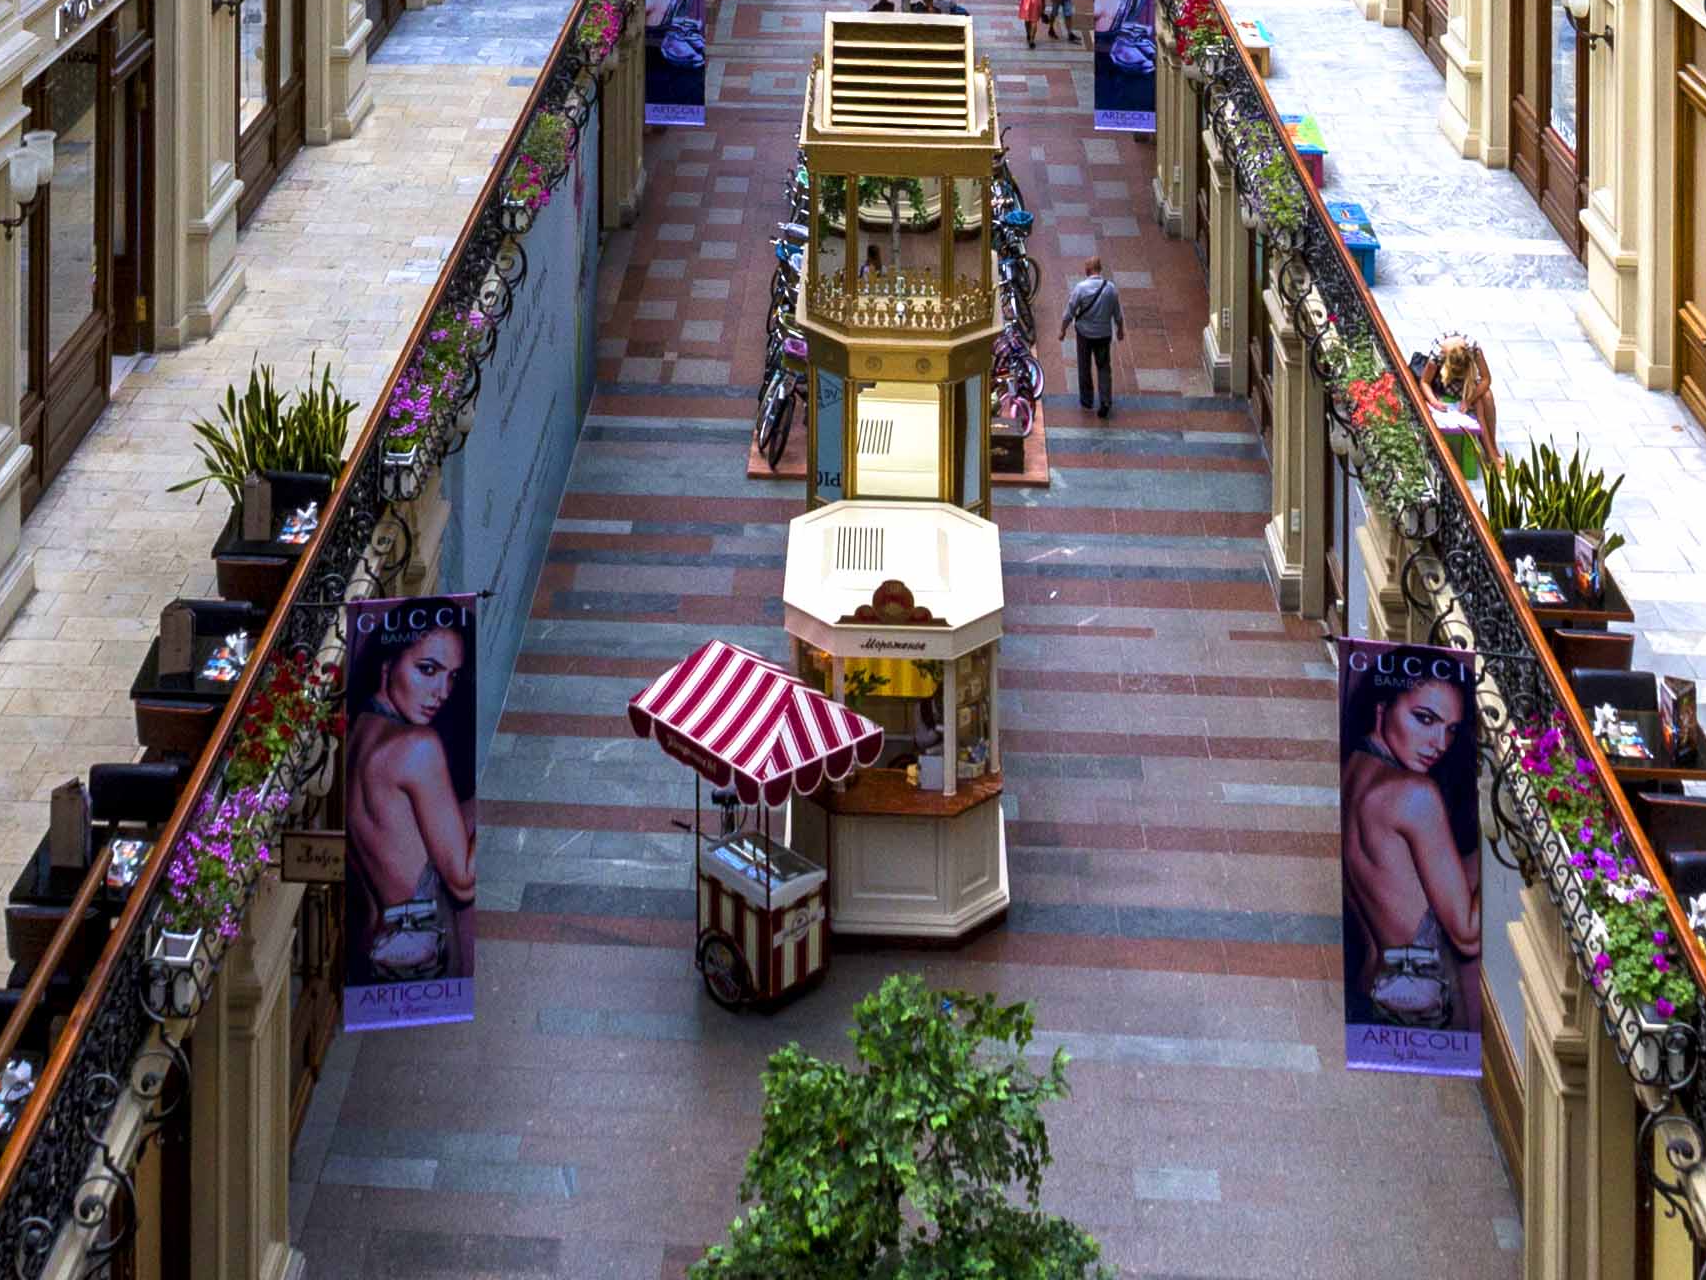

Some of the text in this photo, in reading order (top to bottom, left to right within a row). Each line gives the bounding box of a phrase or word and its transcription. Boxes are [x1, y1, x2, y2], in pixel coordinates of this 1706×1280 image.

[357, 607, 467, 633] GUCCI
[860, 637, 926, 653] Мороженое
[1348, 651, 1467, 683] GUCCI
[359, 981, 463, 1008] ARTICOLI
[1362, 1027, 1470, 1052] ARTICOLI
